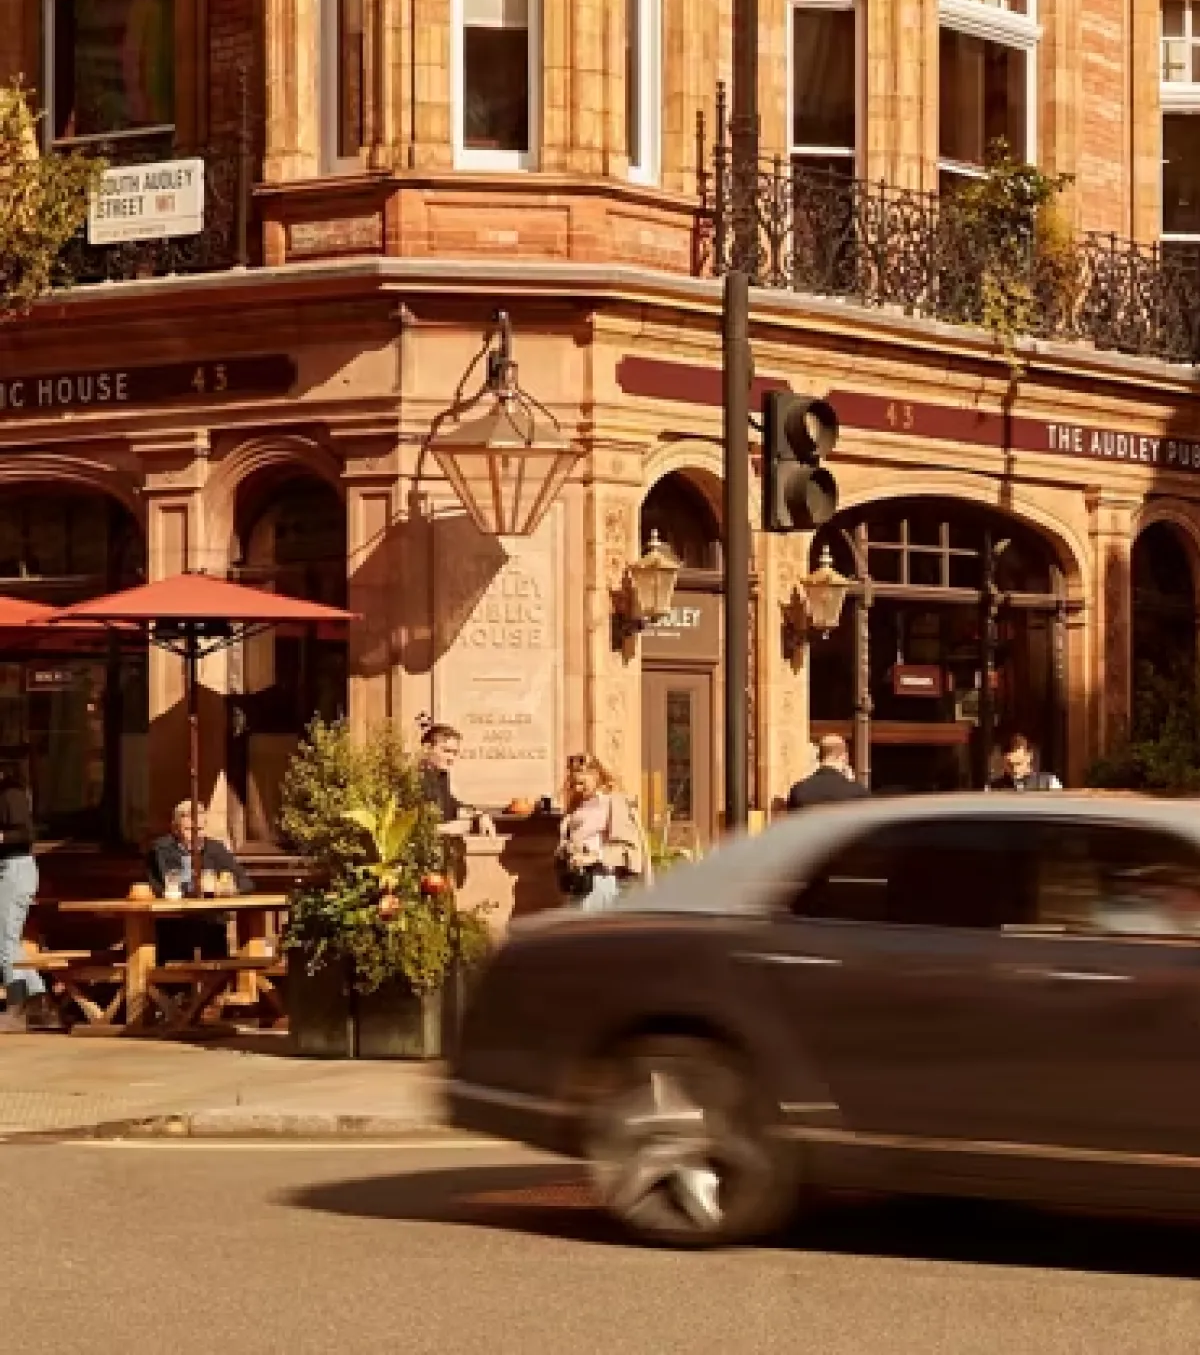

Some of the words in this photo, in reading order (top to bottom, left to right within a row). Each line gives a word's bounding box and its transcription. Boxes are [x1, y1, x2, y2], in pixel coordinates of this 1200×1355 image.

[143, 169, 193, 190] AUDLEY
[97, 195, 144, 219] STREET
[38, 373, 128, 407] HOUSE
[1047, 424, 1083, 452] THE
[1091, 430, 1161, 462] AUDLEY
